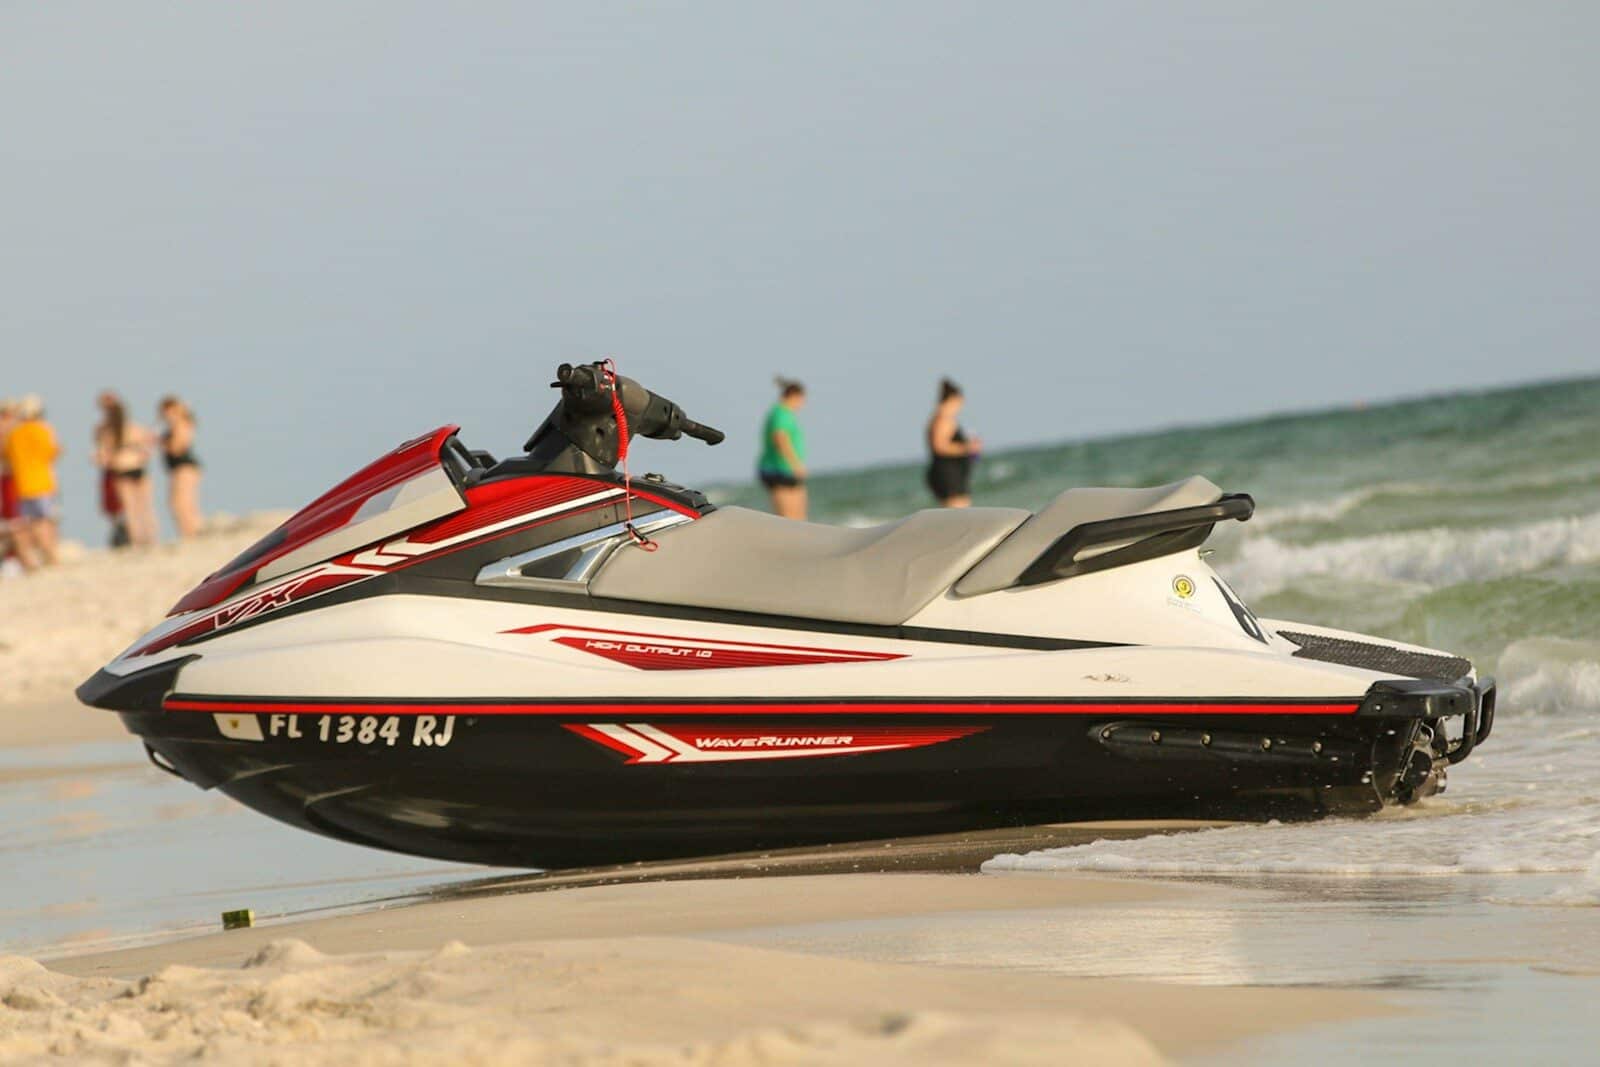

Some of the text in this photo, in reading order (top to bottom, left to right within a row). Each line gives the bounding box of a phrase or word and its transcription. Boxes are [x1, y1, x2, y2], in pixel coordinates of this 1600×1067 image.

[625, 644, 692, 656] OUTPUT
[270, 714, 456, 747] FL 1384 RJ
